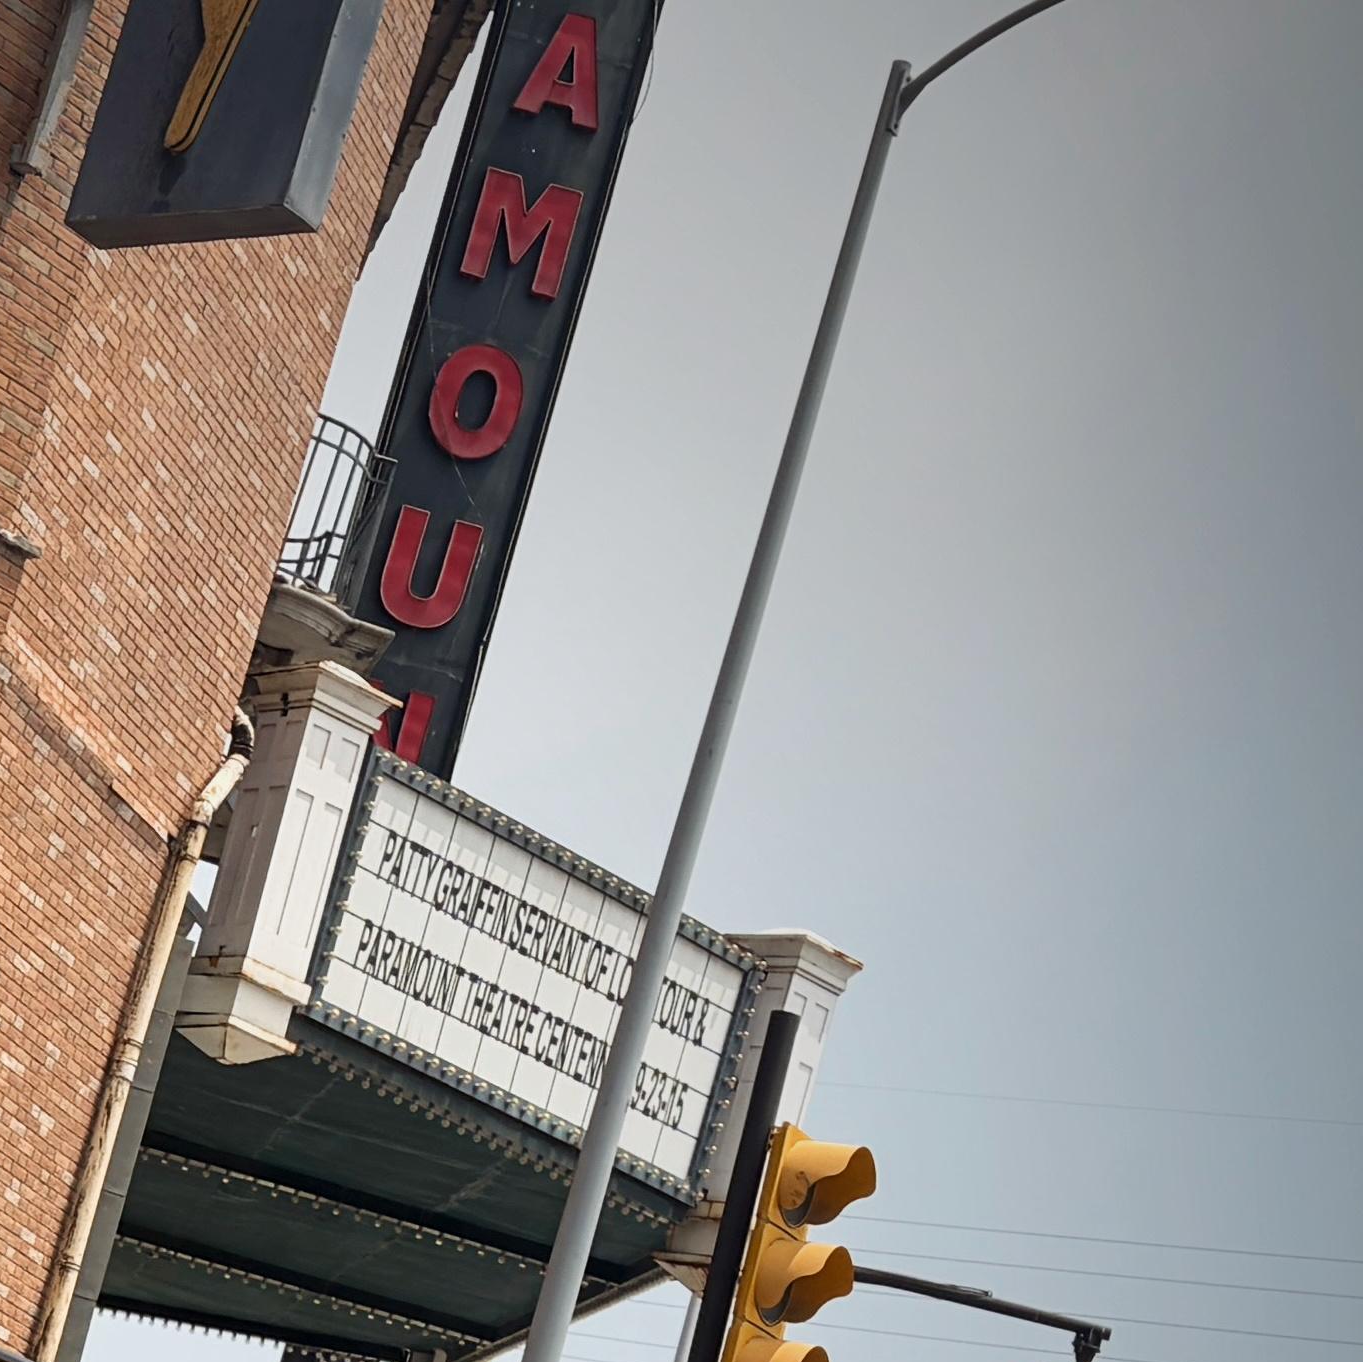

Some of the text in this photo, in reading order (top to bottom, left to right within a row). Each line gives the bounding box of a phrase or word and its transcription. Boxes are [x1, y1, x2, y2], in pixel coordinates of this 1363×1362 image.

[354, 917, 466, 1016] PARAMOUNT
[461, 972, 541, 1055] THEATRE
[377, 830, 440, 902] PATTY
[509, 899, 591, 983] SERVANT
[584, 939, 614, 992] OF
[693, 998, 710, 1047] &
